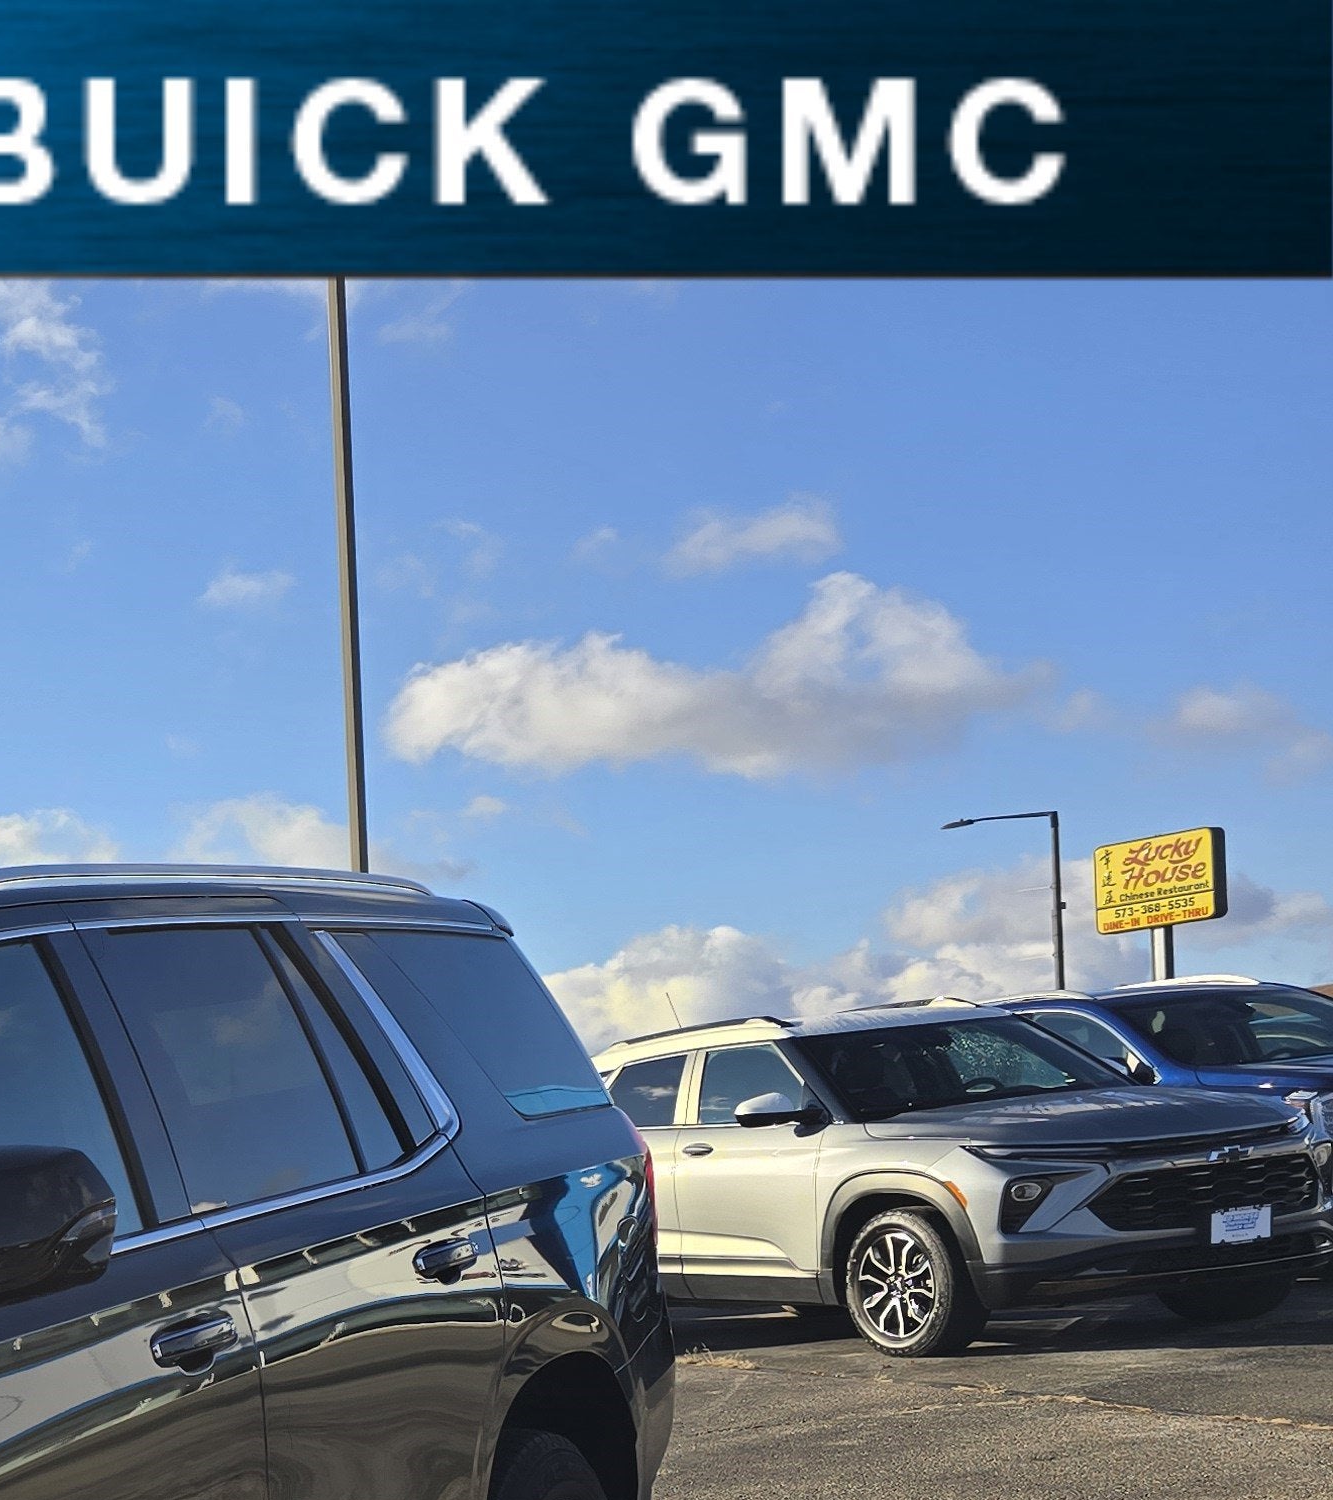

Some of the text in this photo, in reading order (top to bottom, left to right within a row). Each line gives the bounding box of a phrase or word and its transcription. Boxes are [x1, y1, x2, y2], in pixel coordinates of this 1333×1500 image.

[1122, 837, 1203, 867] Lucky
[1120, 861, 1207, 891] House
[1119, 881, 1209, 903] Chinese Restaurant
[1102, 906, 1209, 932] DINE-IN DRIVE-THRU
[1114, 897, 1196, 919] 573-368-5535
